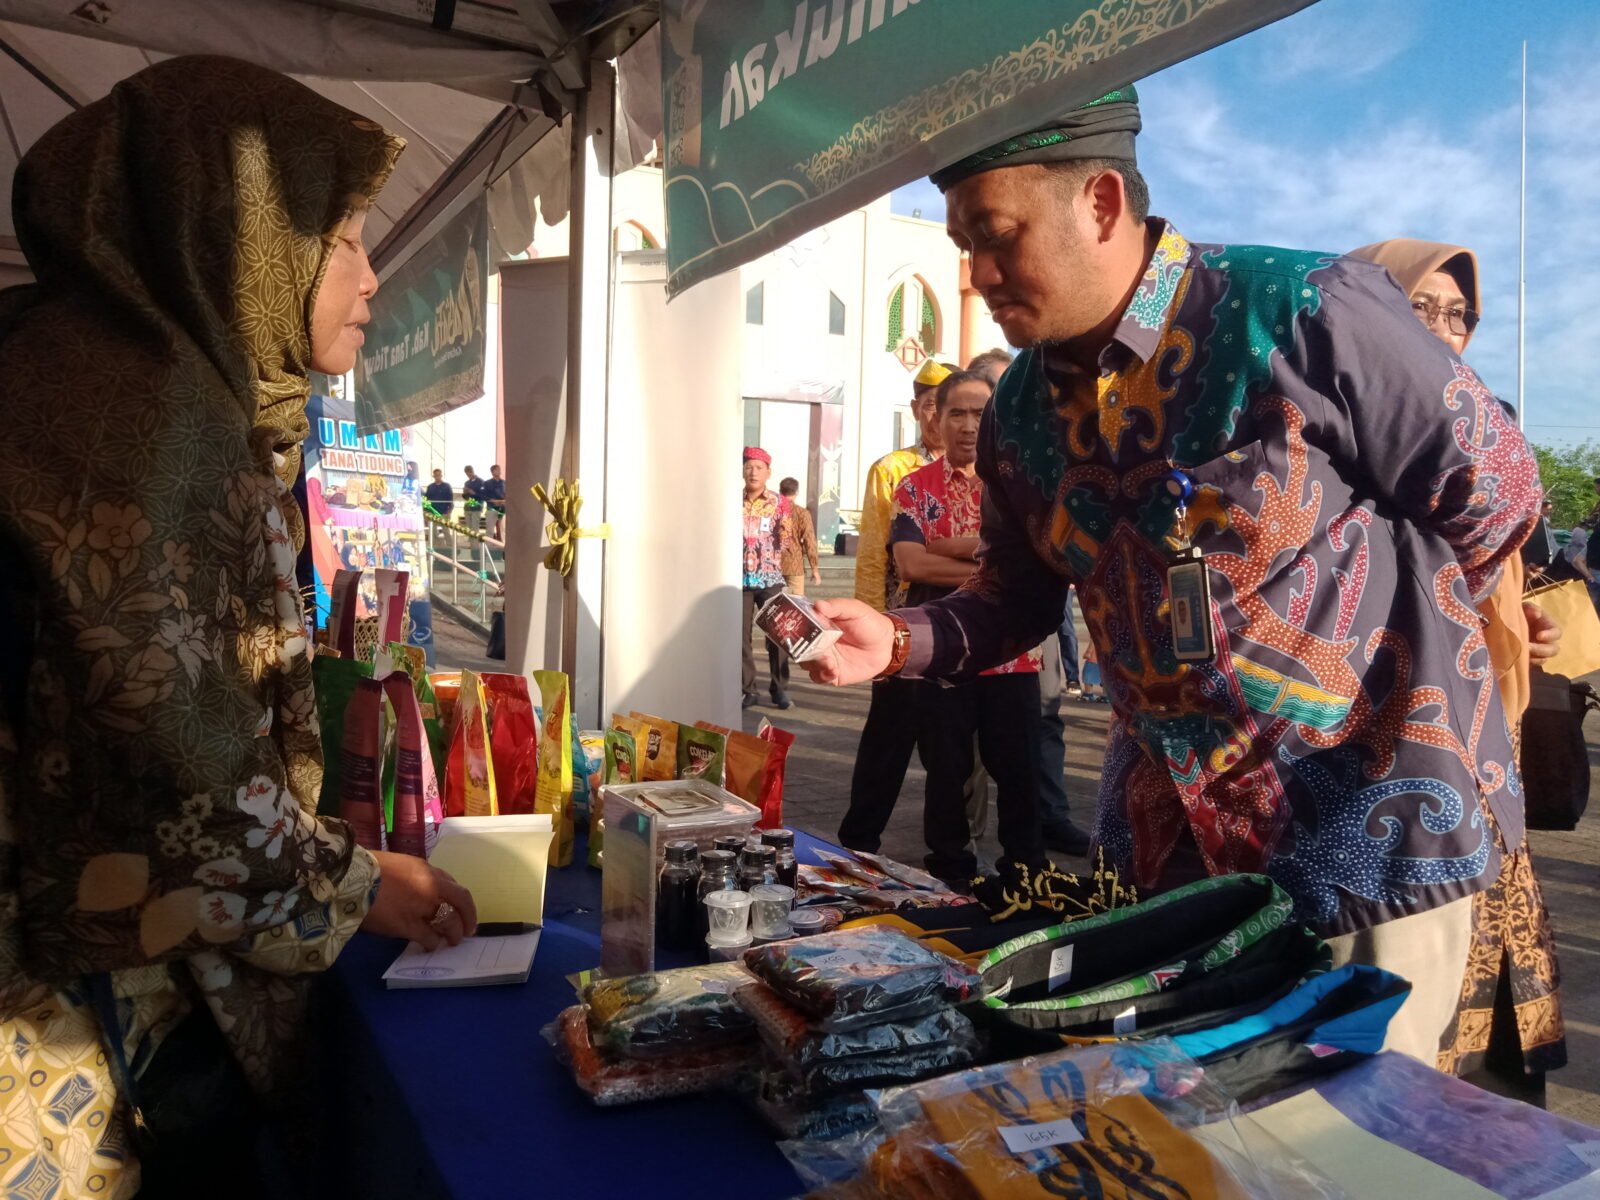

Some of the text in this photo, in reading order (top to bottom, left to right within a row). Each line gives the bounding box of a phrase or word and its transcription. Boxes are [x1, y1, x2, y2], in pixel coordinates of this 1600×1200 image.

[321, 450, 403, 475] TANA TIDUNG
[1024, 1129, 1059, 1144] 165K
